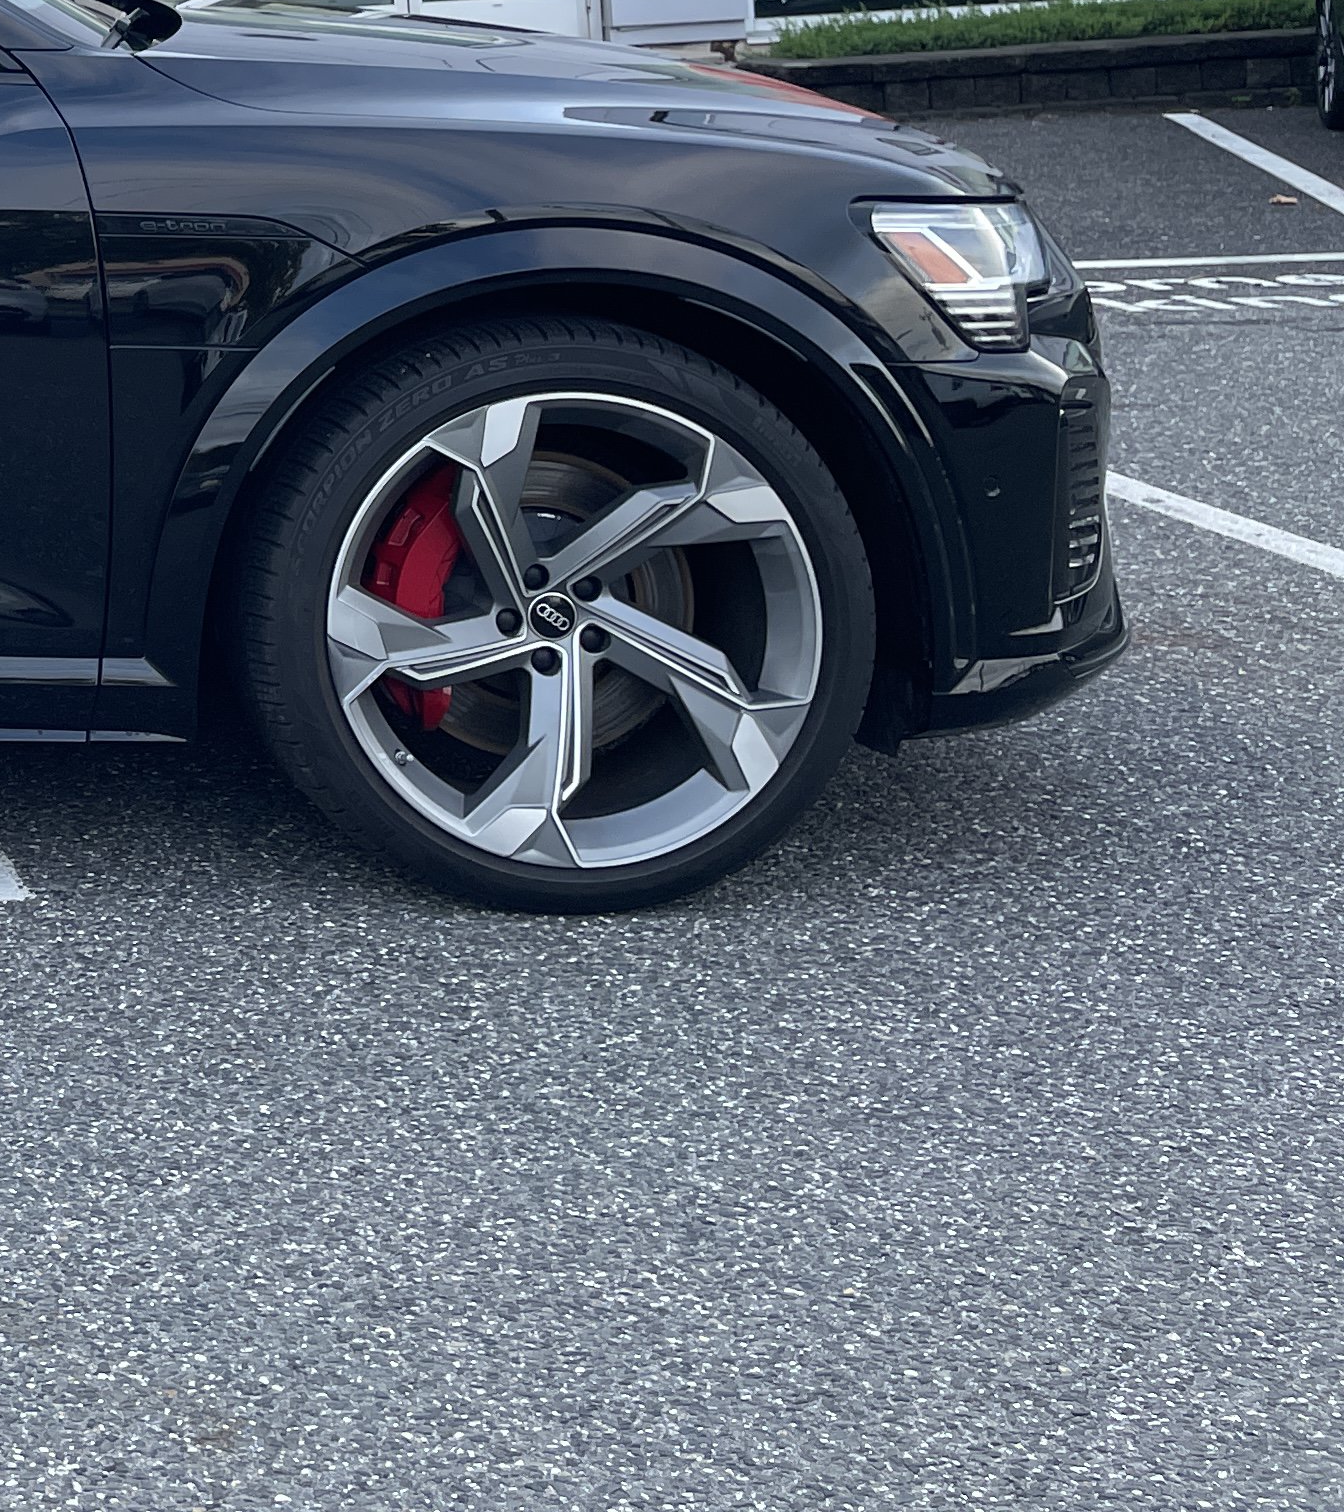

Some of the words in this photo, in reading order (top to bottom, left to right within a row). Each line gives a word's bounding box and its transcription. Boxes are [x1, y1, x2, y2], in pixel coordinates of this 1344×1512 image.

[140, 219, 226, 233] e-tron
[378, 375, 452, 432] ZERO
[464, 355, 508, 380] AS
